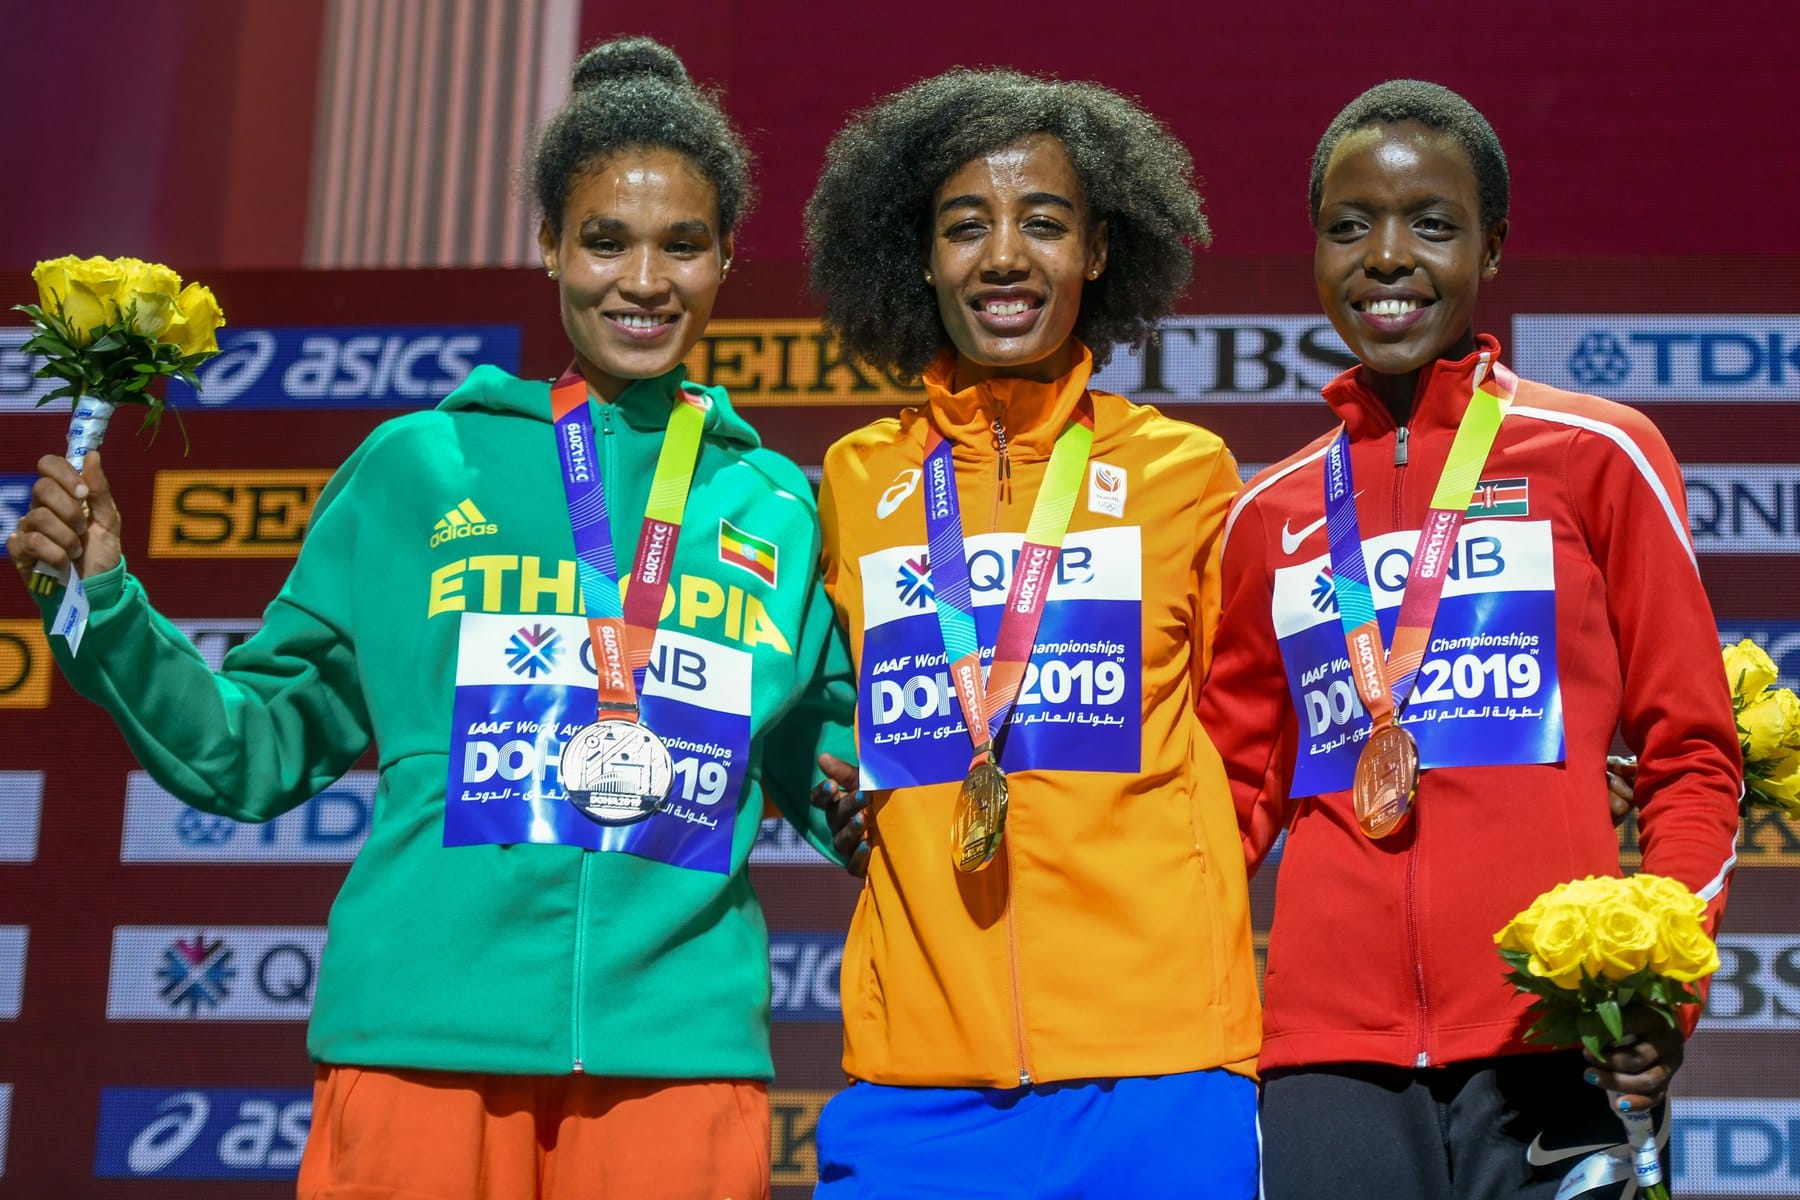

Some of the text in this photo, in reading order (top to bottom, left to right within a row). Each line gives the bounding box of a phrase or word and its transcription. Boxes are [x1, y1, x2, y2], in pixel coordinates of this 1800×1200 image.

[283, 336, 482, 400] asics
[430, 523, 498, 548] adidas
[427, 555, 793, 656] ETHPIA
[872, 656, 911, 676] IAAF
[1301, 663, 1329, 688] IAAF
[1431, 632, 1539, 653] Championships
[467, 721, 513, 735] IAAF
